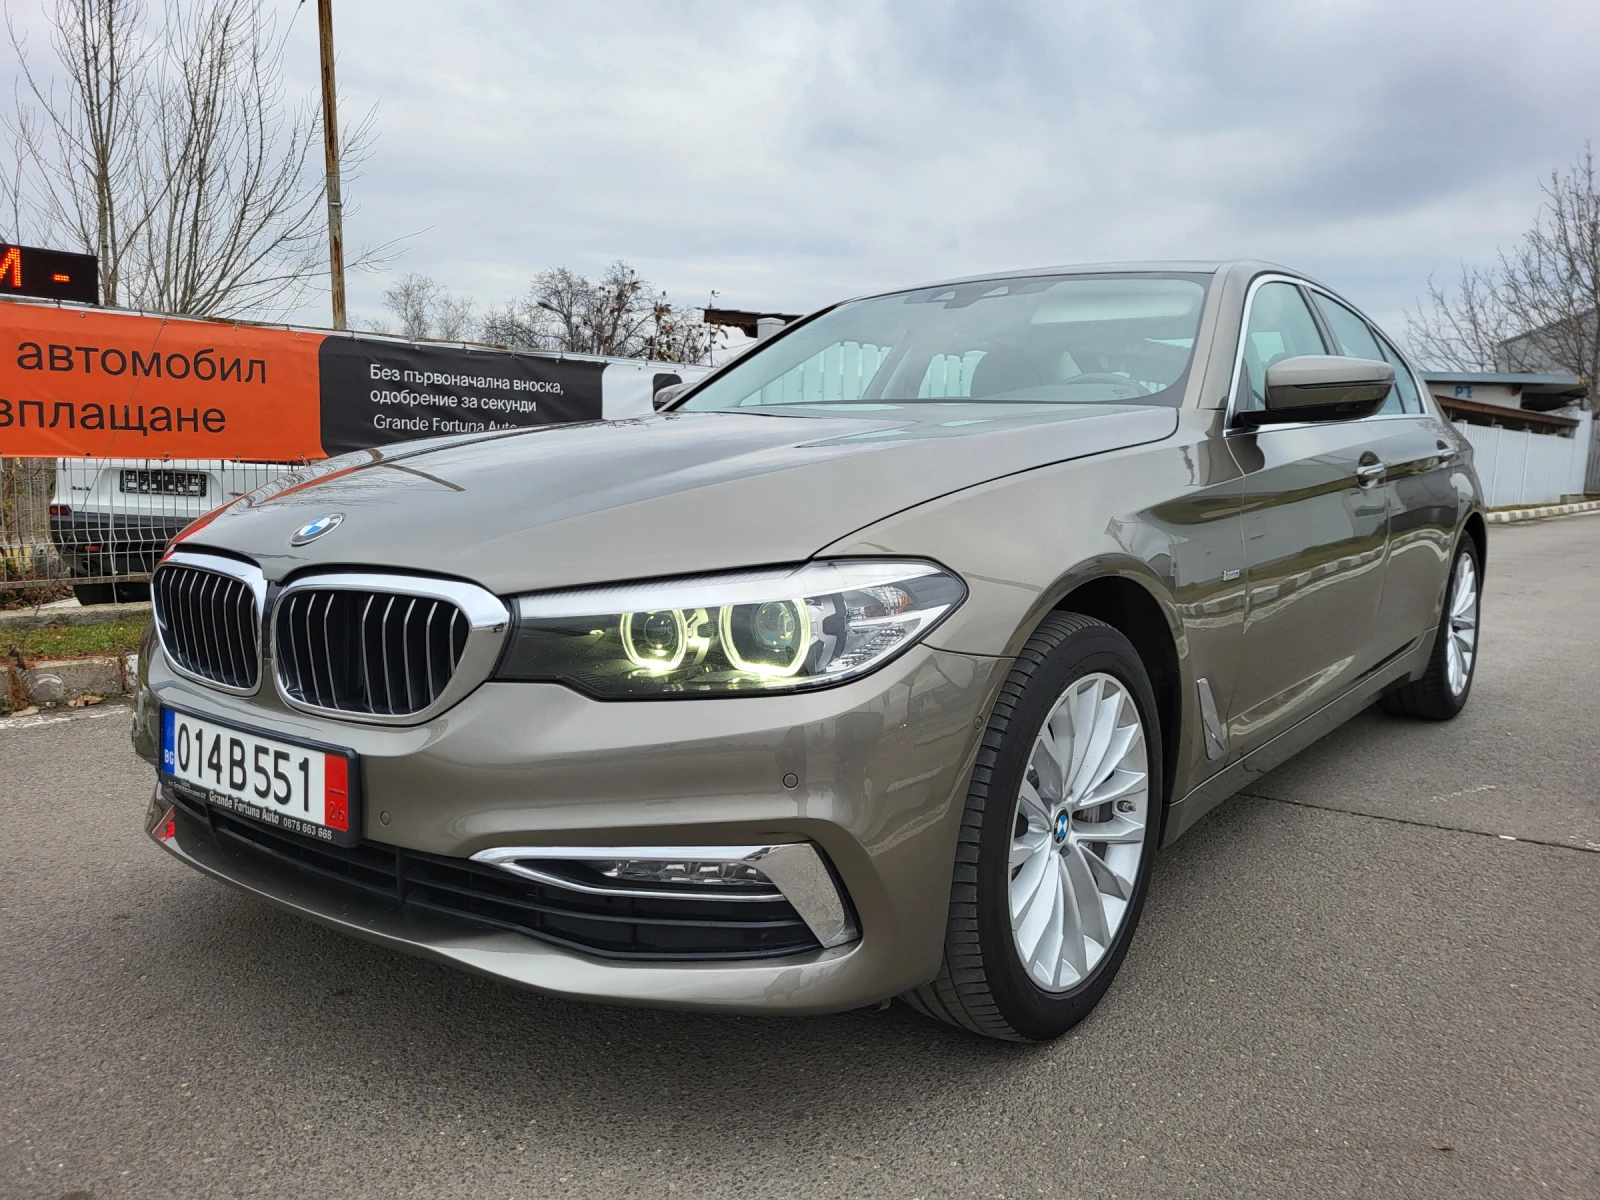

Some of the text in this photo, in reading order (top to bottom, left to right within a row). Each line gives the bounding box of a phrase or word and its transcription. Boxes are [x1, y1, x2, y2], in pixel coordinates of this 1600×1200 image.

[17, 341, 267, 384] автомобил
[370, 363, 564, 396] Без първоначална вноска,
[370, 389, 537, 413] одобрение за секунди
[373, 414, 429, 431] Grande
[432, 417, 485, 432] Fortuna
[164, 748, 175, 765] BG
[177, 722, 311, 812] 014B551
[208, 790, 233, 809] Grande
[234, 798, 260, 818] Fortuna
[261, 808, 280, 825] Auto
[283, 817, 300, 831] 0878
[302, 823, 316, 835] 663
[318, 828, 332, 840] 668
